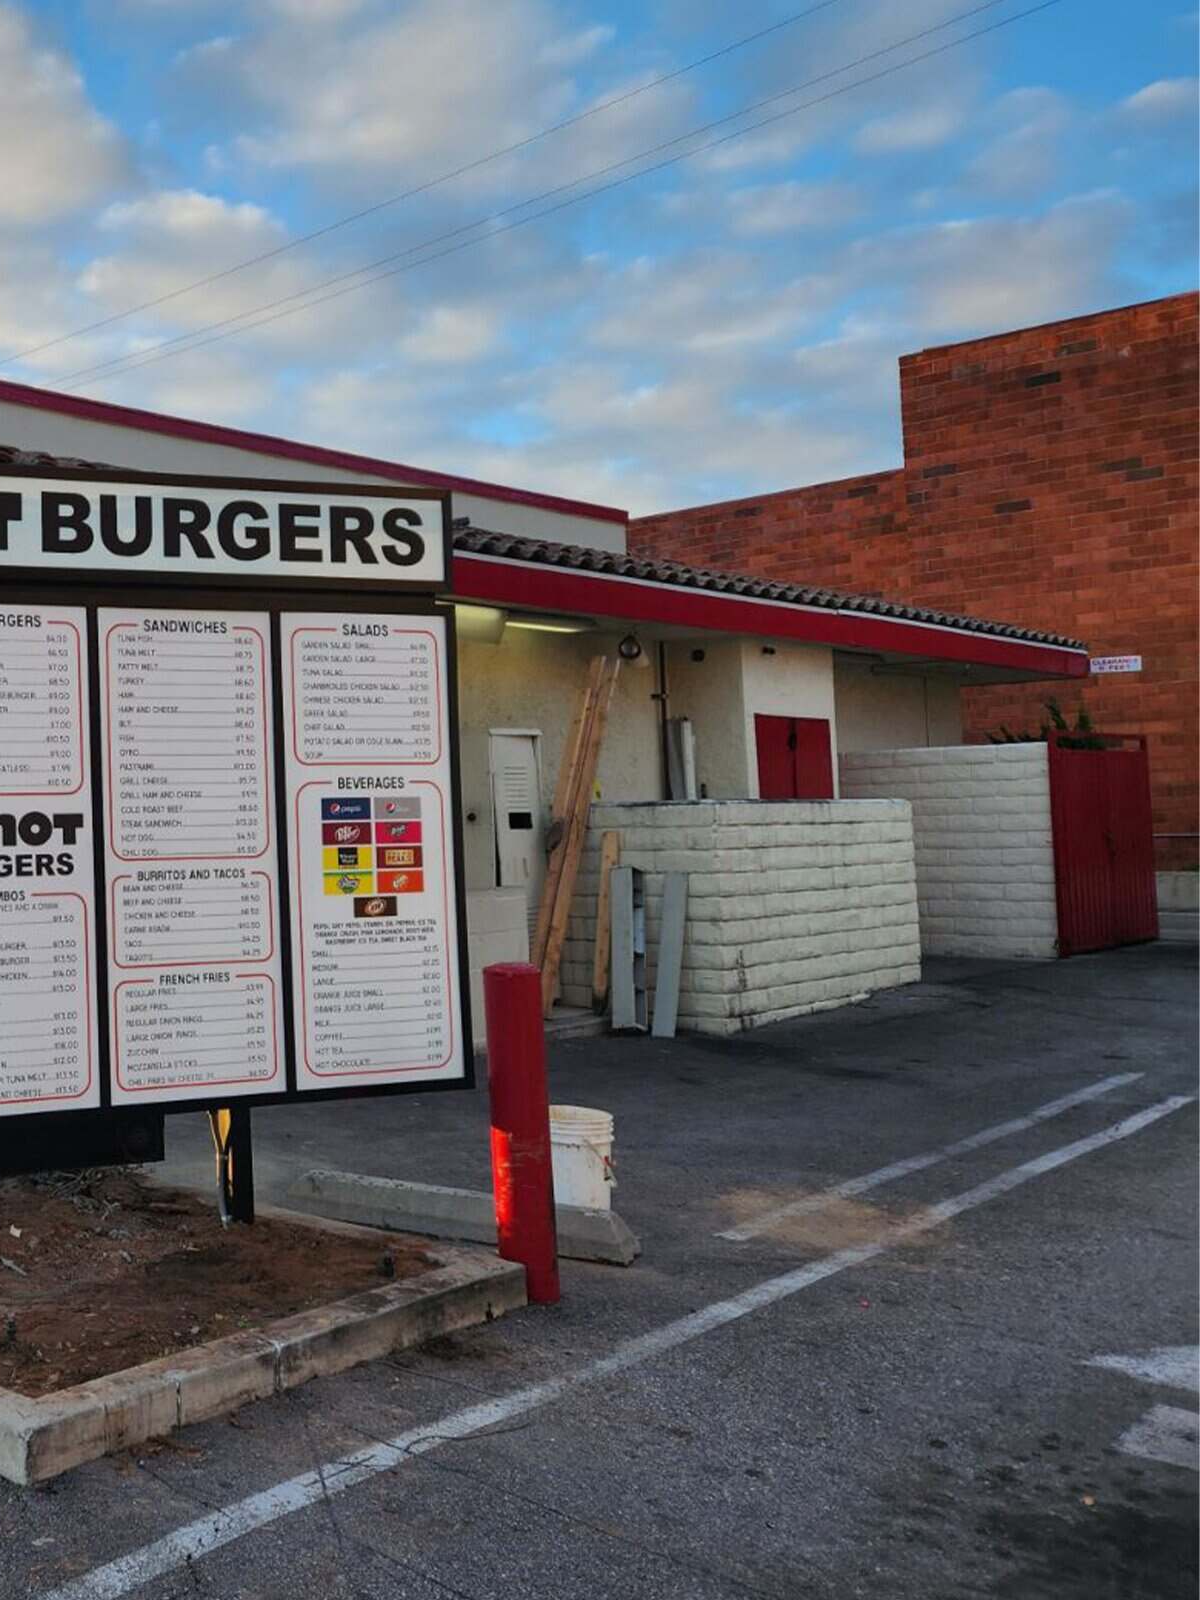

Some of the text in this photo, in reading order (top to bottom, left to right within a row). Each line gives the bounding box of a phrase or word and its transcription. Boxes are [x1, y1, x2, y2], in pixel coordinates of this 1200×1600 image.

[41, 491, 424, 566] BURGERS
[144, 619, 227, 634] SANDWICHES
[343, 624, 388, 637] SALADS
[338, 777, 405, 789] BEVERAGES
[137, 869, 245, 881] BURRITOS AND TACOS
[159, 973, 230, 985] FRENCH FRIES
